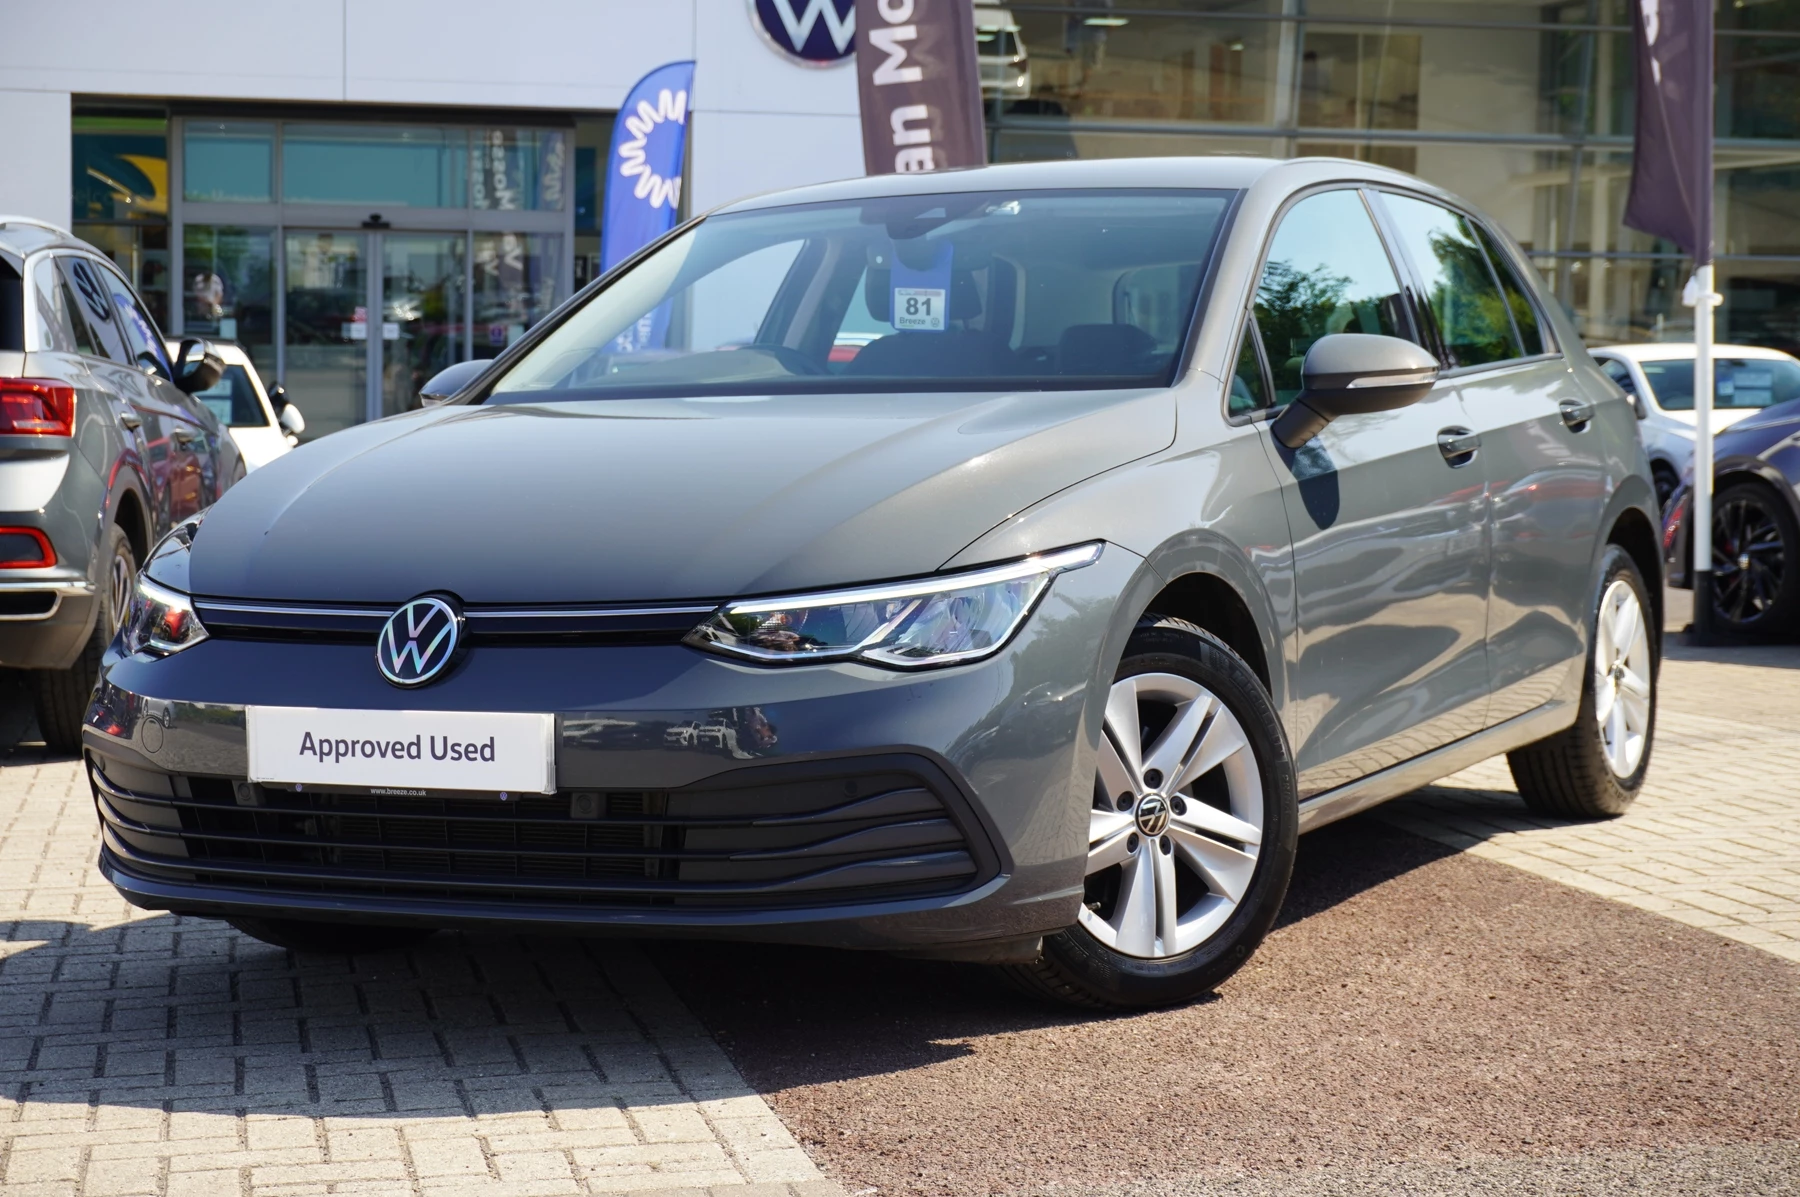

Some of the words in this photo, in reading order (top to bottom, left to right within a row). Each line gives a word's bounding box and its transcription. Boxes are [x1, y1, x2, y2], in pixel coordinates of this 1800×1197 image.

[889, 104, 936, 173] an
[905, 297, 931, 317] 81
[899, 317, 926, 325] Breeze
[299, 731, 422, 763] Approved
[429, 735, 496, 762] Used
[370, 787, 427, 796] www.breeze.co.uk
